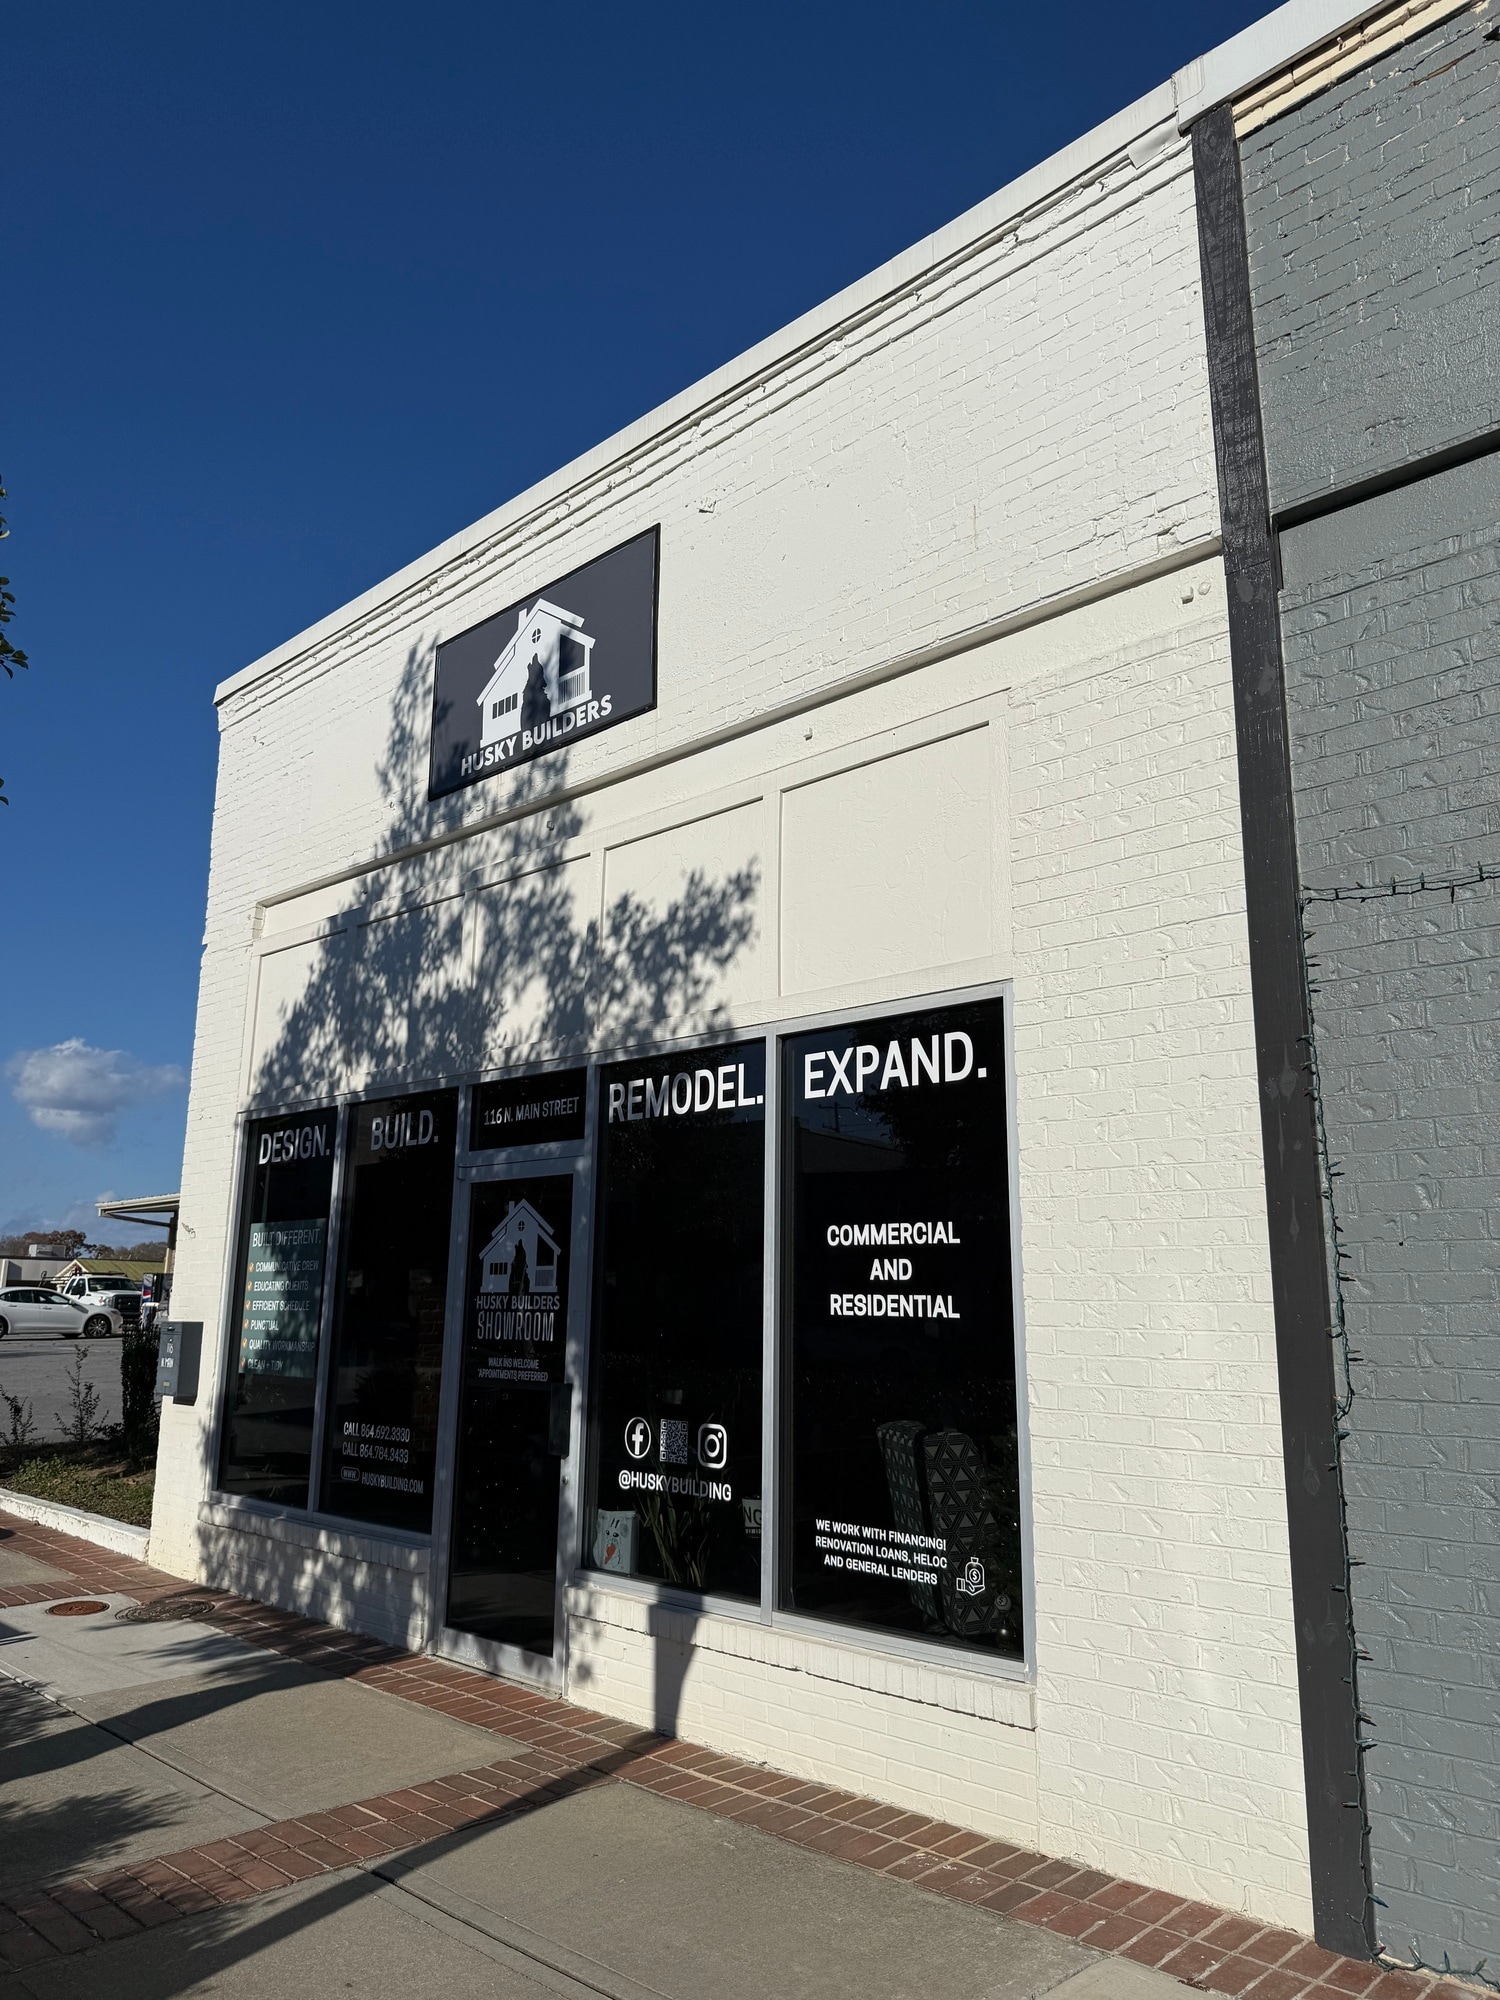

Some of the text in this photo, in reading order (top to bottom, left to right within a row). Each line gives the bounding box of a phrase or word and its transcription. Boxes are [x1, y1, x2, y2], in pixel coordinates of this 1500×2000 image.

[461, 694, 613, 776] HUSKY BUILDERS
[803, 1031, 988, 1100] EXPAND.
[608, 1062, 764, 1124] REMODEL.
[484, 1096, 580, 1125] 116 N. MAIN STREET
[370, 1109, 439, 1151] BUILD.
[258, 1124, 331, 1165] DESIGN.
[252, 1228, 322, 1247] BUILT DIFFERENT.
[826, 1221, 961, 1247] COMMERCIAL
[301, 1260, 320, 1271] CREW
[869, 1258, 913, 1282] AND
[253, 1280, 285, 1292] EDUCATING
[252, 1300, 279, 1311] EFFICIENT
[476, 1295, 560, 1310] HUSKY BUILDERS
[829, 1293, 961, 1319] RESIDENTIAL
[250, 1319, 279, 1331] PUNCTUAL
[477, 1311, 554, 1342] SHOWROOM
[249, 1338, 272, 1350] QUALITY
[247, 1358, 265, 1370] CLEAN
[270, 1360, 283, 1371] TIDY
[513, 1358, 539, 1369] WELCOME
[517, 1370, 548, 1382] PREFERRED
[343, 1421, 360, 1437] CALL
[342, 1441, 359, 1457] CALL
[361, 1471, 424, 1494] HUSKYBUILDING.COM
[618, 1469, 732, 1501] @HUSKYBUILDING
[815, 1518, 947, 1551] WE WORK WITH FINANCING!
[815, 1535, 948, 1569] RENOVATION LOANS, HELOC
[823, 1554, 938, 1585] AND GENERAL LENDERS
